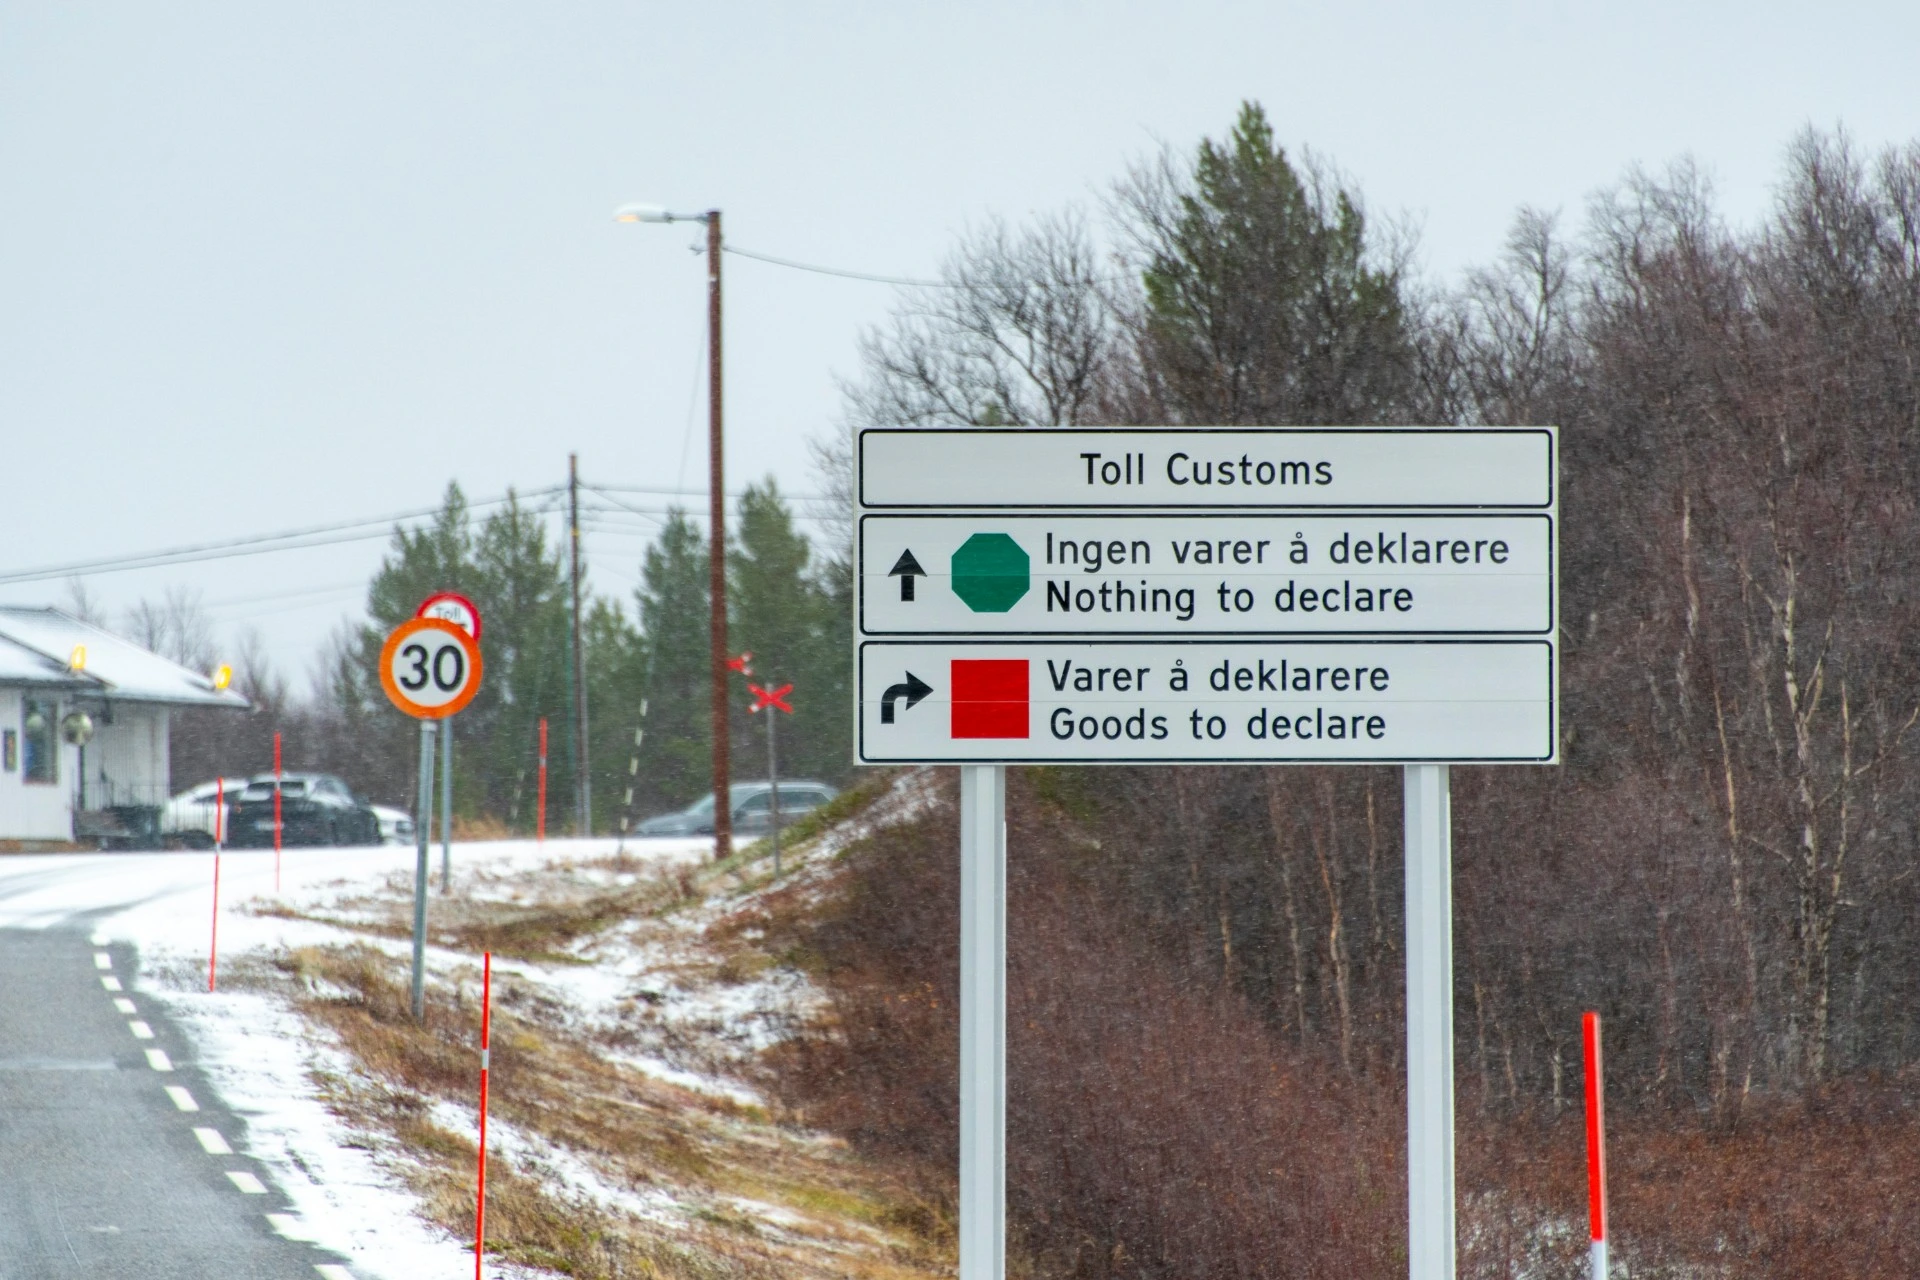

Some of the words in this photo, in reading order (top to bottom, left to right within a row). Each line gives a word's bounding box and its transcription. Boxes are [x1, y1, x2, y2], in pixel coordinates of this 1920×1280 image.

[1079, 452, 1144, 486] Toll
[1166, 452, 1333, 486] Customs
[1046, 532, 1151, 574] Ingen
[1171, 540, 1271, 565] varer
[1289, 531, 1308, 565] å
[1329, 531, 1509, 565] deklarere
[434, 606, 461, 620] Toll
[1046, 579, 1195, 622] Nothing
[1216, 581, 1254, 613] to
[1274, 579, 1414, 613] declare
[399, 644, 464, 692] 30
[1046, 659, 1151, 692] Varer
[1169, 658, 1188, 692] å
[1209, 659, 1390, 692] deklarere
[1050, 707, 1169, 741] Goods
[1189, 708, 1227, 740] to
[1247, 707, 1386, 740] declare
